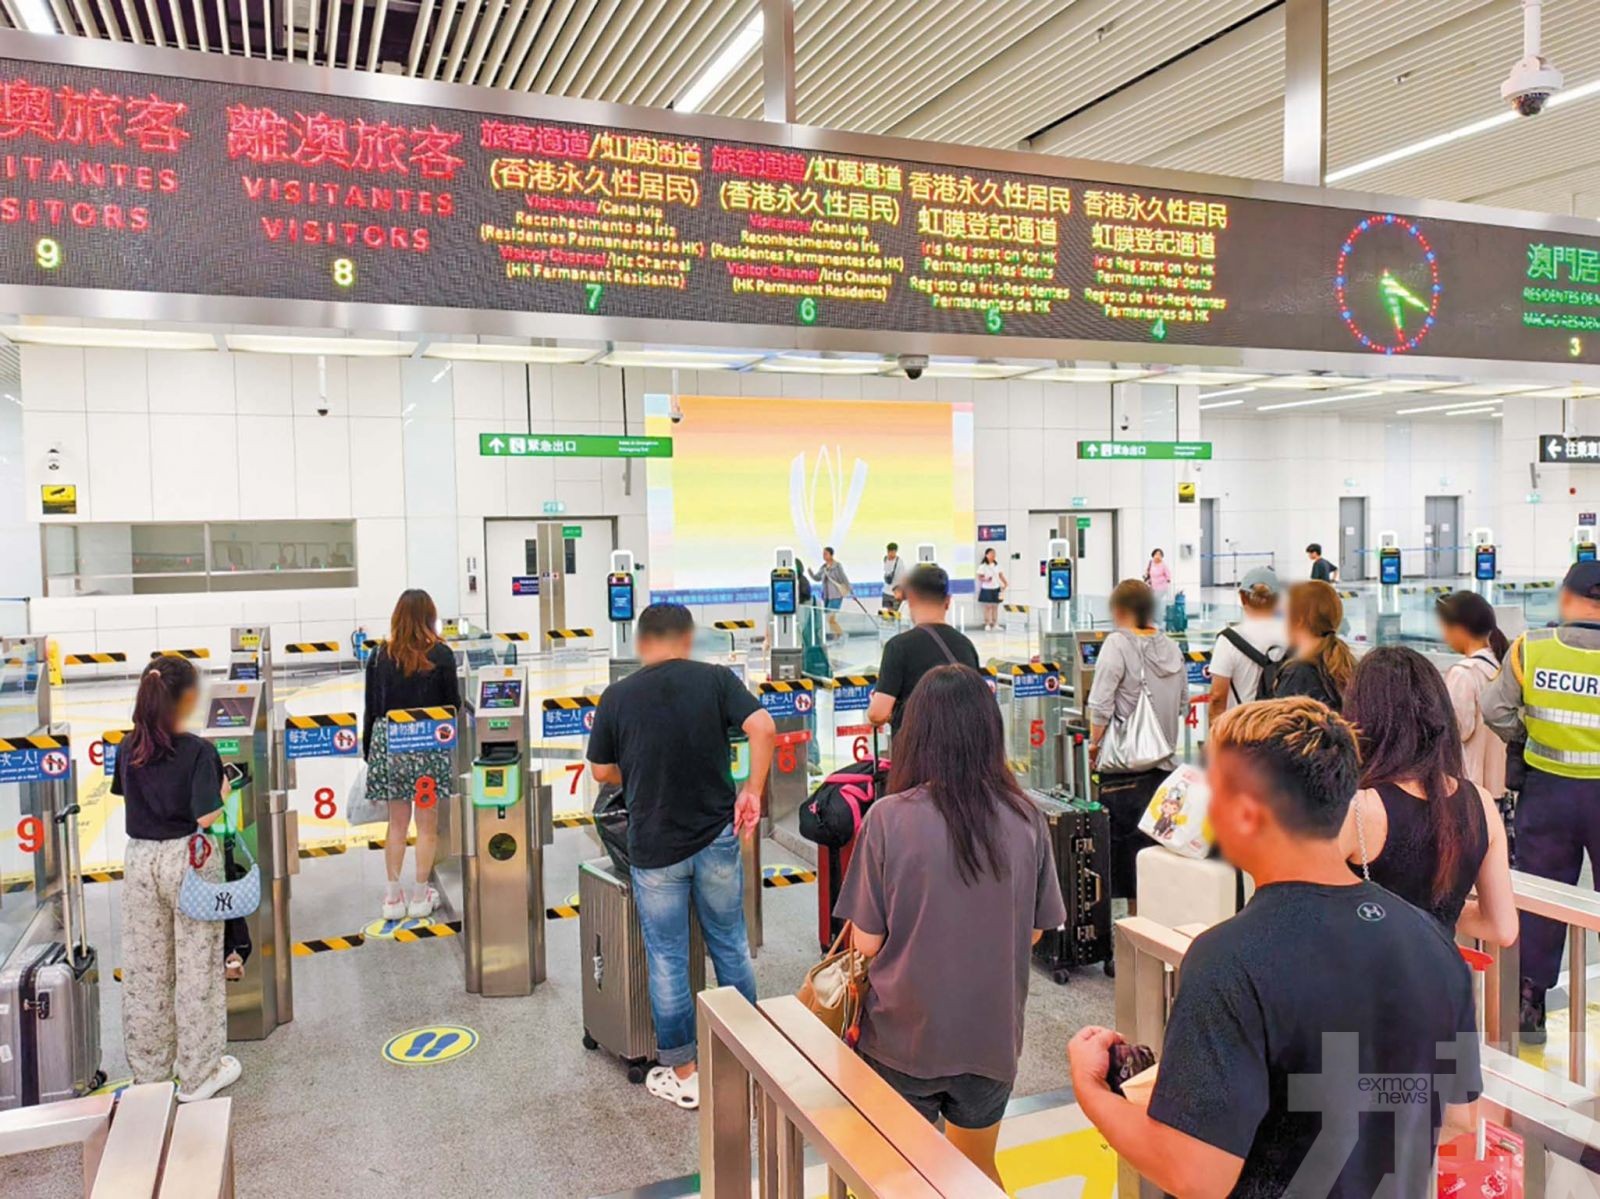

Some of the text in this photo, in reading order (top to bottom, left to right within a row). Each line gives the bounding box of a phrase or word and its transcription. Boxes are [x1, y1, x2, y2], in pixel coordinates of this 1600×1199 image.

[227, 103, 466, 180] 離澳旅客
[5, 155, 180, 194] ITANTES
[490, 157, 699, 207] (香港永久性居民)
[242, 175, 455, 217] VISITANTES
[719, 180, 900, 226] (香港永久性居民)
[908, 171, 1071, 214] 香港永久性居民
[0, 197, 150, 233] SITORS
[1083, 190, 1228, 228] 香港永久性居民
[261, 216, 431, 252] VISITORS
[741, 230, 842, 251] Reconhecimento
[918, 205, 1058, 245] 虹膜登記通道
[1091, 222, 1216, 259] 虹膜登記通道
[36, 238, 60, 269] 9
[710, 242, 784, 261] (Residentes
[786, 250, 865, 268] Permanentes
[884, 256, 904, 272] HK)
[1527, 243, 1600, 284] 澳門居
[333, 257, 354, 287] 8
[726, 262, 768, 275] Visitor
[844, 270, 892, 285] Channel
[585, 283, 603, 311] 7
[733, 278, 887, 302] (HK Permanent Residents)
[799, 297, 816, 322] 6
[986, 309, 1001, 331] 5
[1151, 319, 1166, 339] 4
[1569, 337, 1581, 356] 3
[527, 438, 576, 453] 緊急出口
[1185, 705, 1199, 729] 4
[853, 736, 869, 762] 6
[1030, 719, 1047, 748] 5
[415, 775, 437, 809] 8
[565, 763, 585, 795] 7
[314, 787, 337, 819] 8
[17, 817, 45, 853] 9
[215, 892, 233, 911] NY
